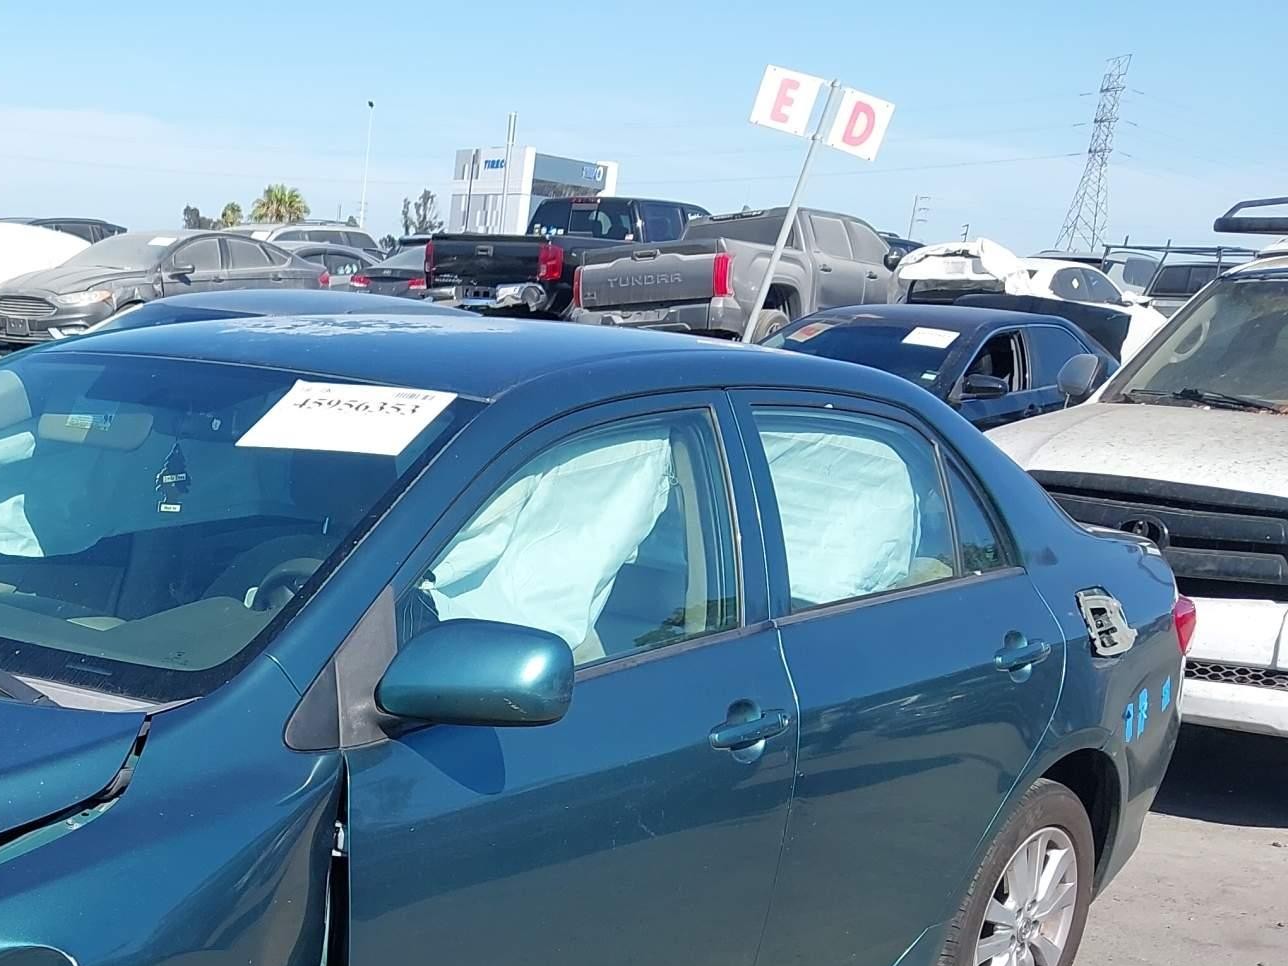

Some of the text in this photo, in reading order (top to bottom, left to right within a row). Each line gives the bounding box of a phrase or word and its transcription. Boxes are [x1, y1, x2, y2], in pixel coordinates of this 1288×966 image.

[770, 78, 800, 124] E
[842, 100, 876, 147] D
[608, 273, 682, 288] TUNDRA
[292, 397, 420, 416] 45956353
